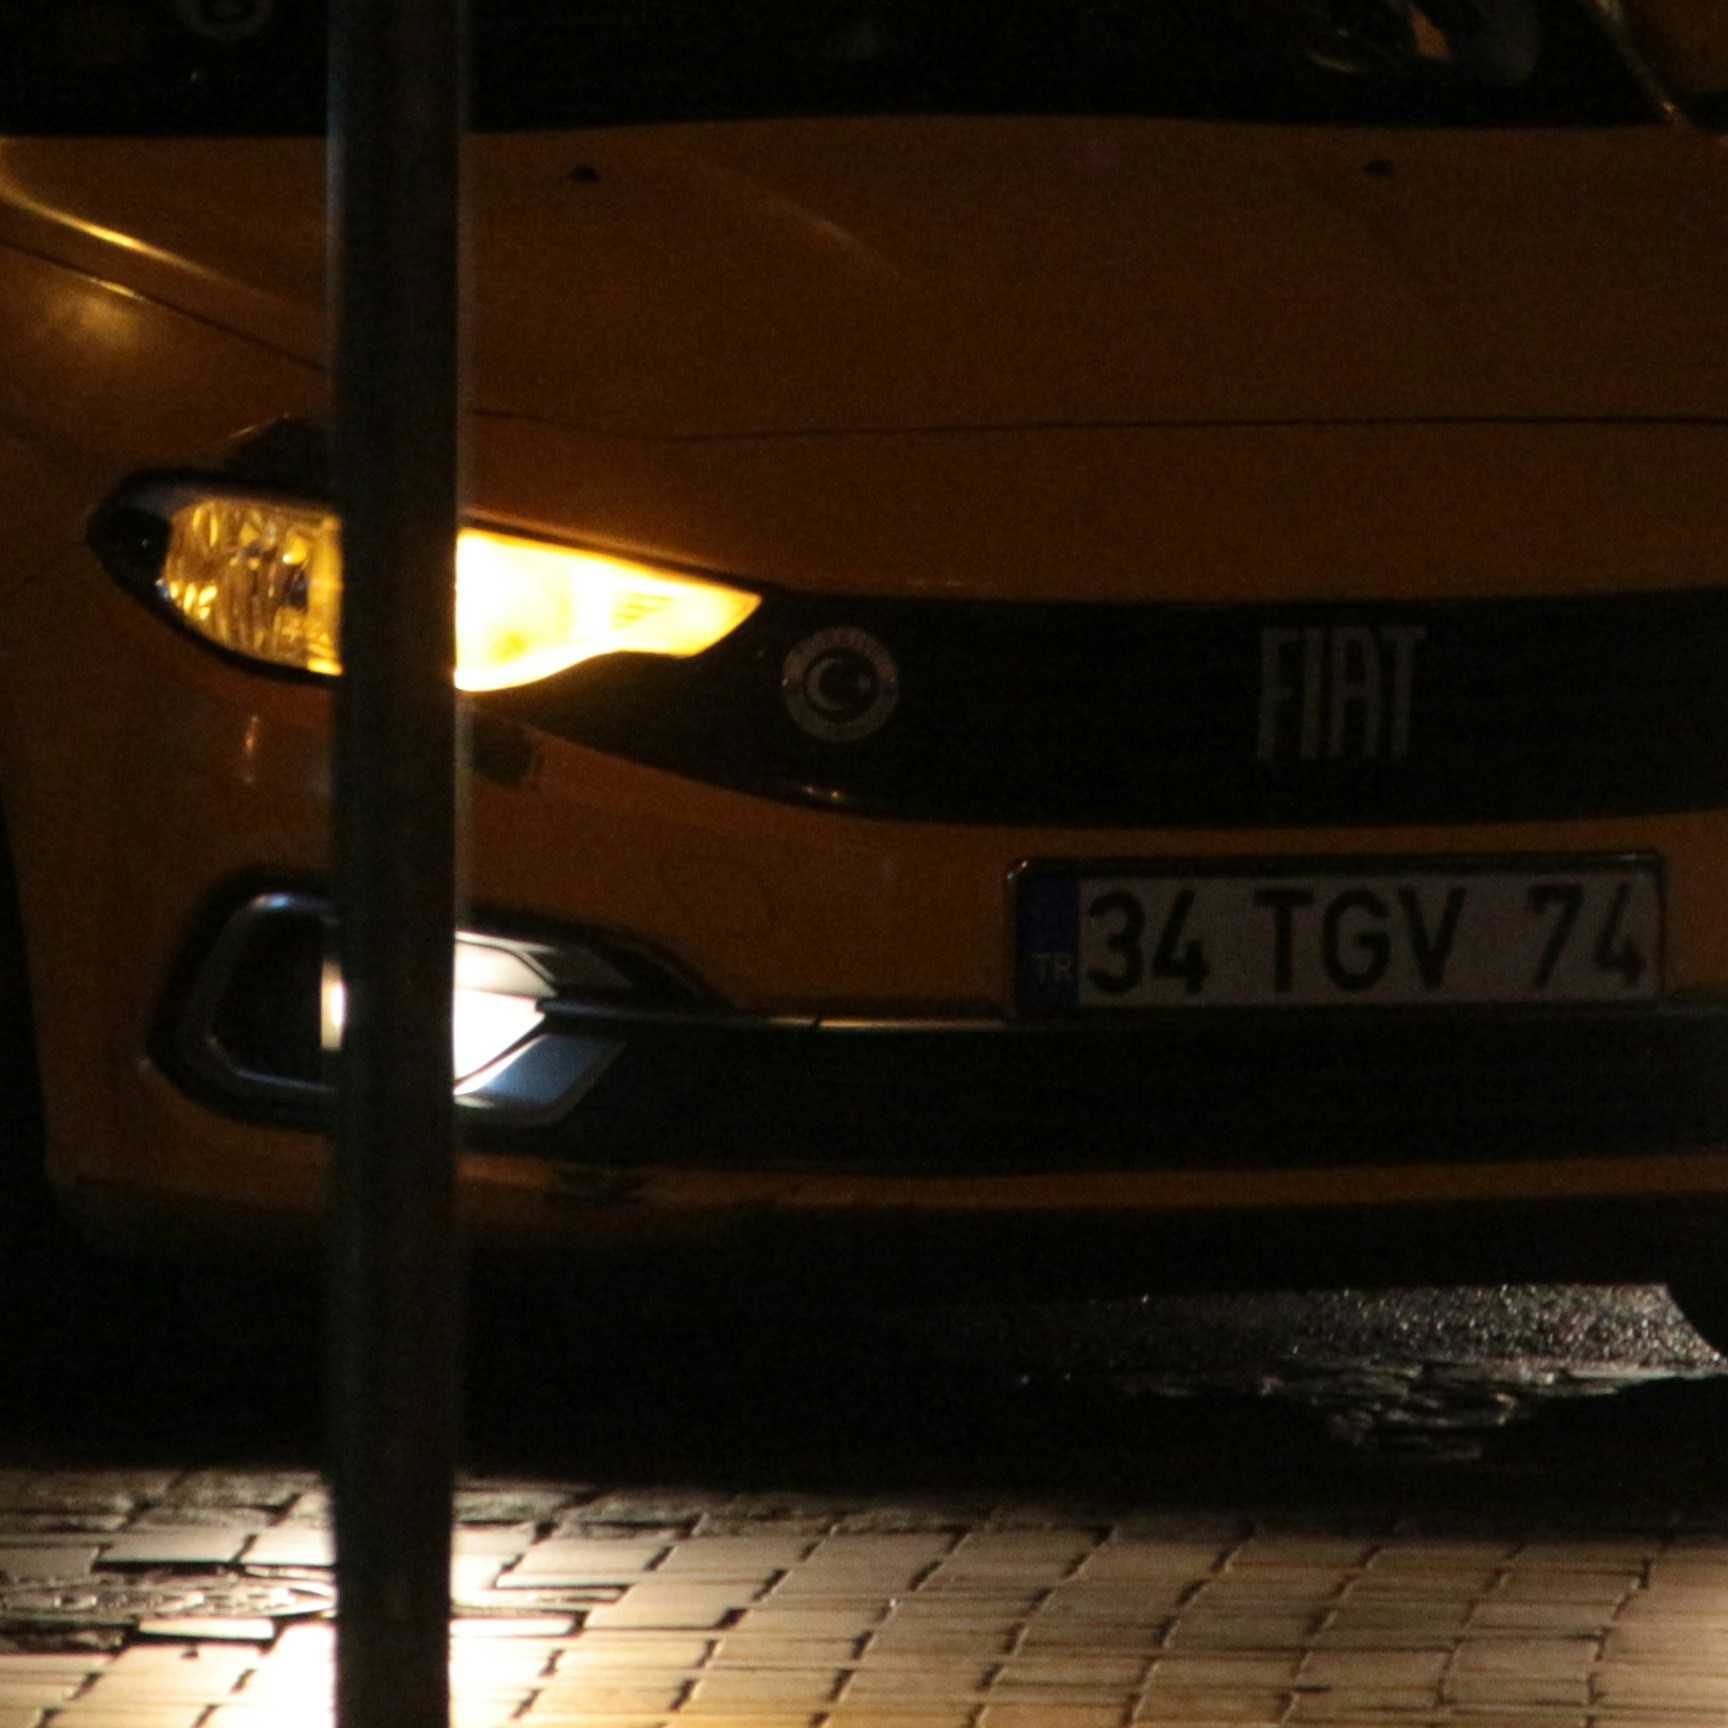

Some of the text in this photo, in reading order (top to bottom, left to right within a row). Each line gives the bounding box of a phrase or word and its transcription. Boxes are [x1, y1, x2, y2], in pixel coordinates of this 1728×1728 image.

[1257, 625, 1428, 762] FIAT
[1087, 888, 1210, 995] 34
[1252, 887, 1466, 992] TGV
[1527, 883, 1645, 990] 74
